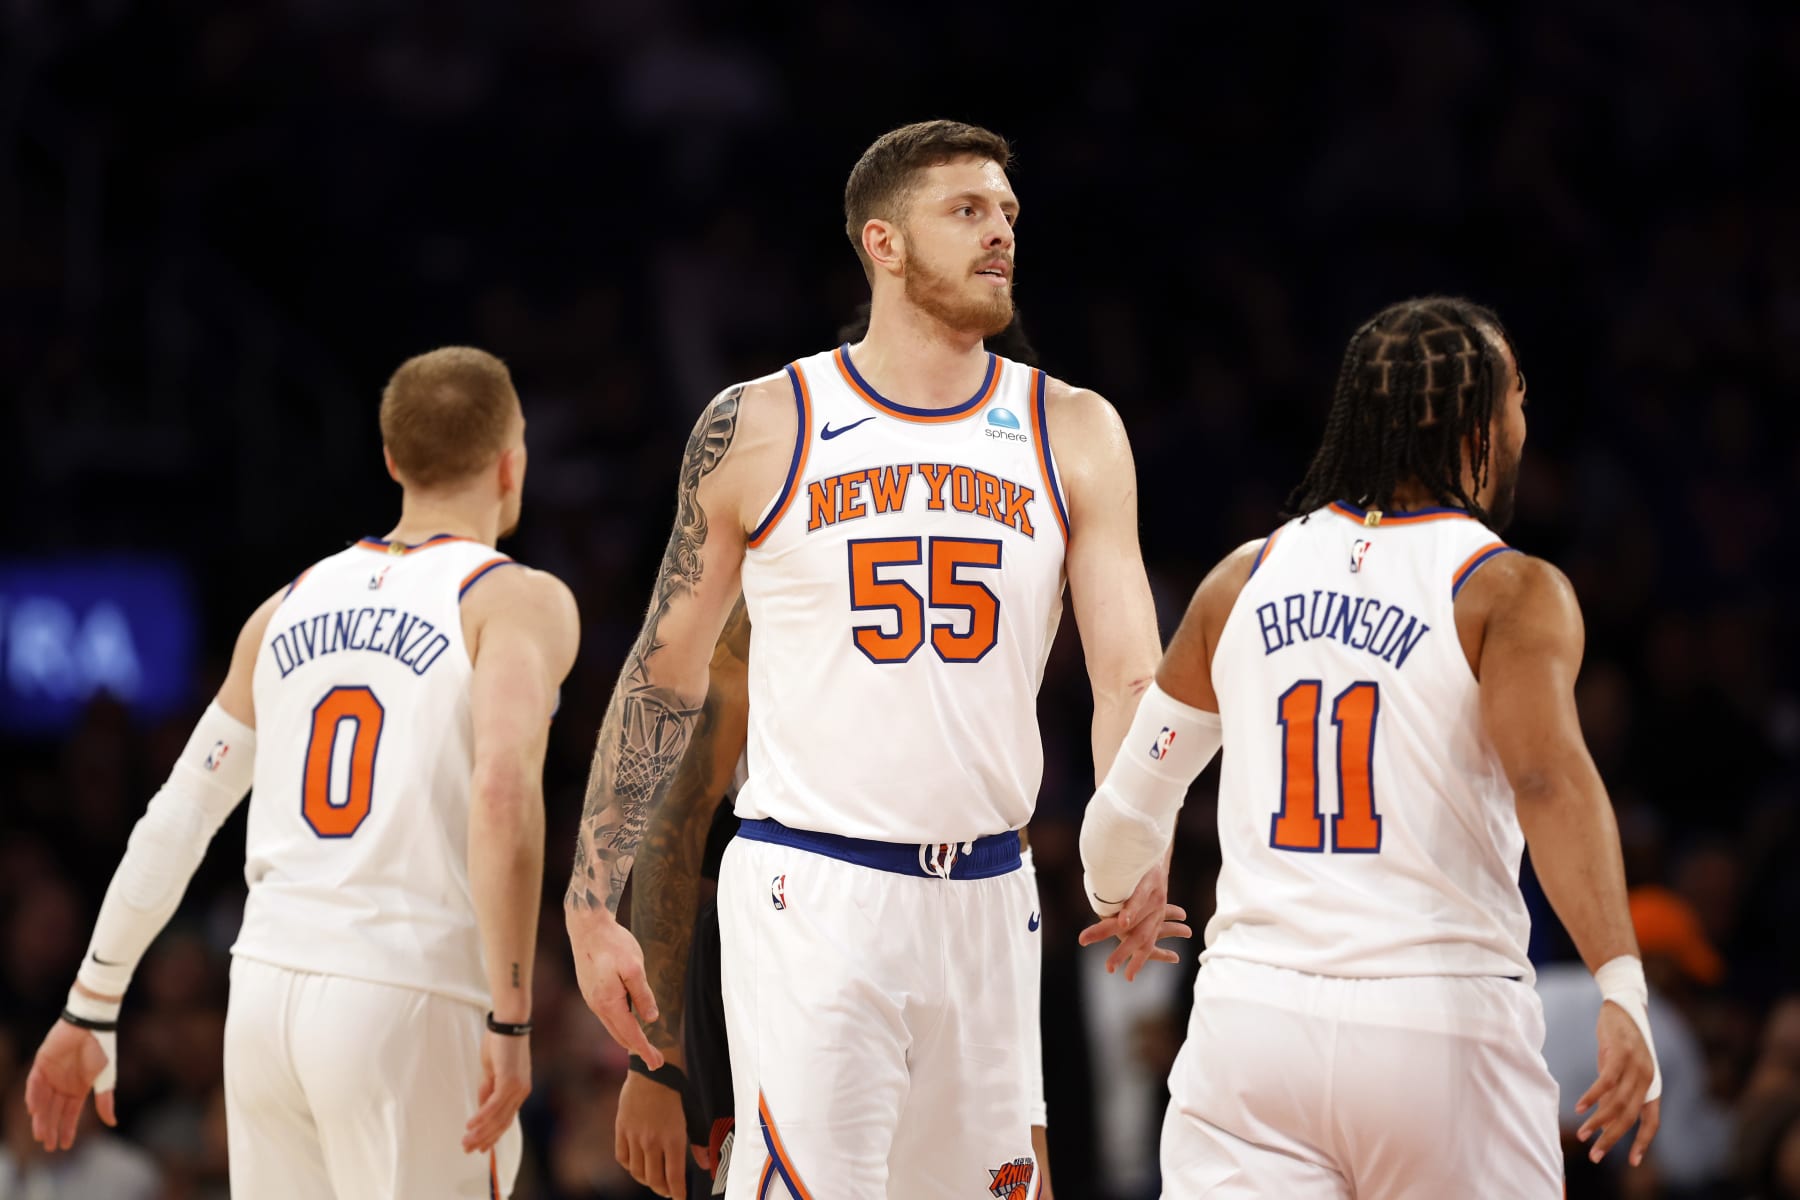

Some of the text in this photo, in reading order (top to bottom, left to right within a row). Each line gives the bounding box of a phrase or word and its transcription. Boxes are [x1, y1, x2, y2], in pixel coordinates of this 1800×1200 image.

[985, 428, 1028, 443] sphere
[807, 462, 1035, 540] NEW YORK
[271, 607, 450, 679] DIVINCENZO
[847, 536, 1003, 664] 55
[1256, 590, 1430, 670] BRUNSON
[0, 596, 142, 699] RA
[301, 685, 385, 838] 0
[1269, 679, 1382, 854] 11
